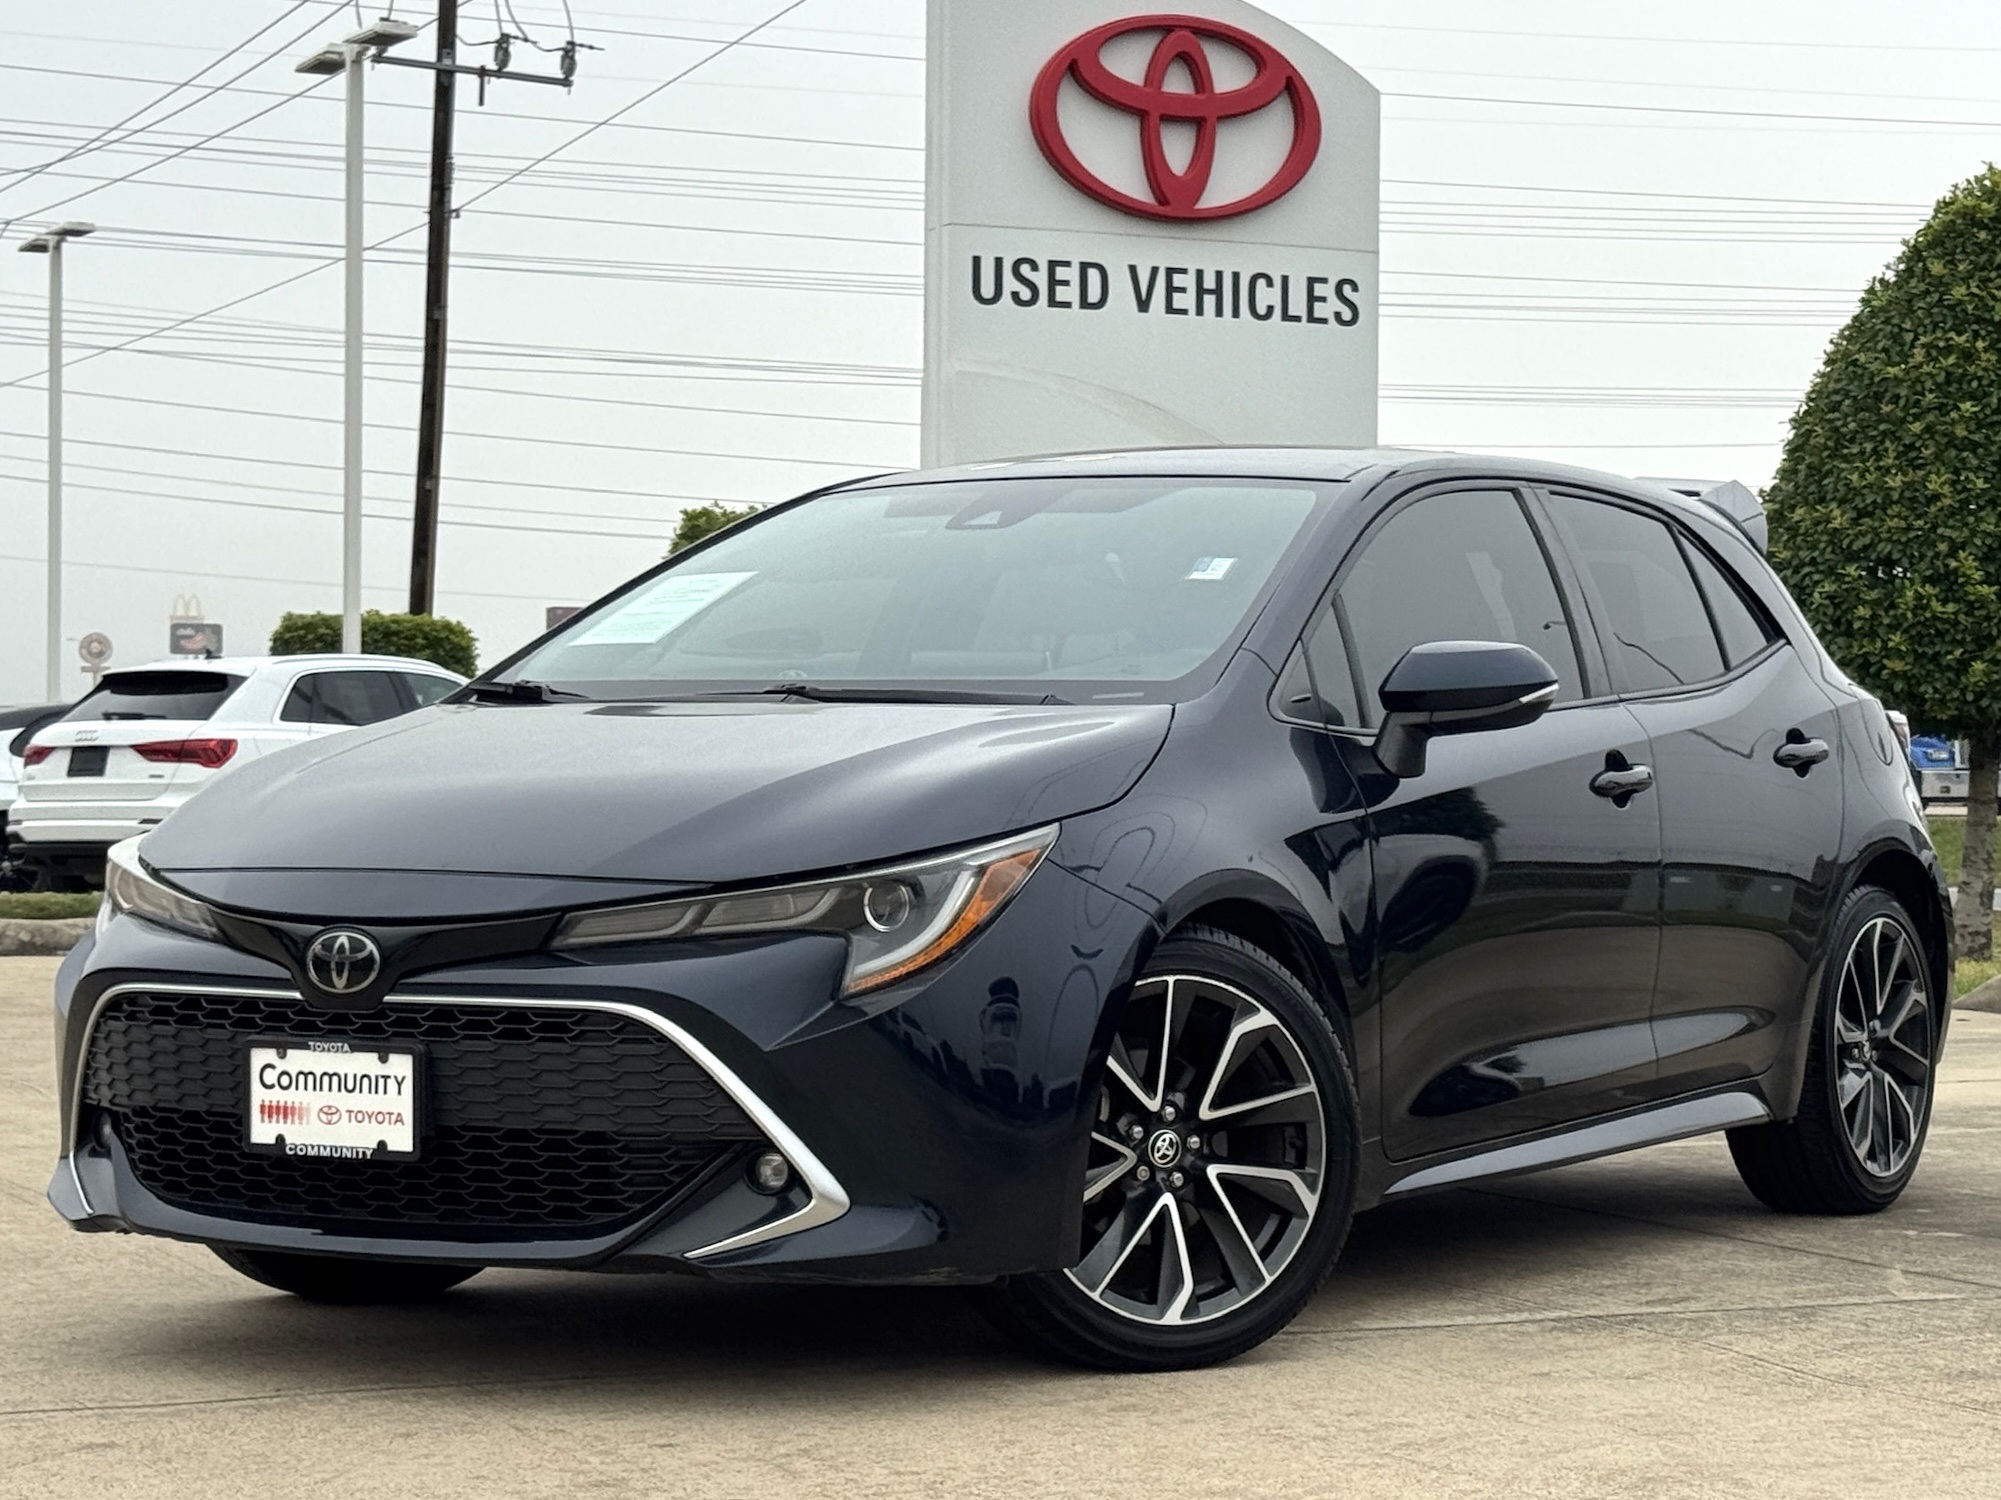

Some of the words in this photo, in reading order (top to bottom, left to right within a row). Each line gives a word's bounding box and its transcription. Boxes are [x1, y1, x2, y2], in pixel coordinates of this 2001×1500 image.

[971, 255, 1109, 310] USED
[1127, 264, 1360, 327] VEHICLES
[308, 1041, 351, 1053] TOYOTA
[345, 1110, 405, 1126] TOYOTA
[285, 1144, 374, 1159] COMMUNITY
